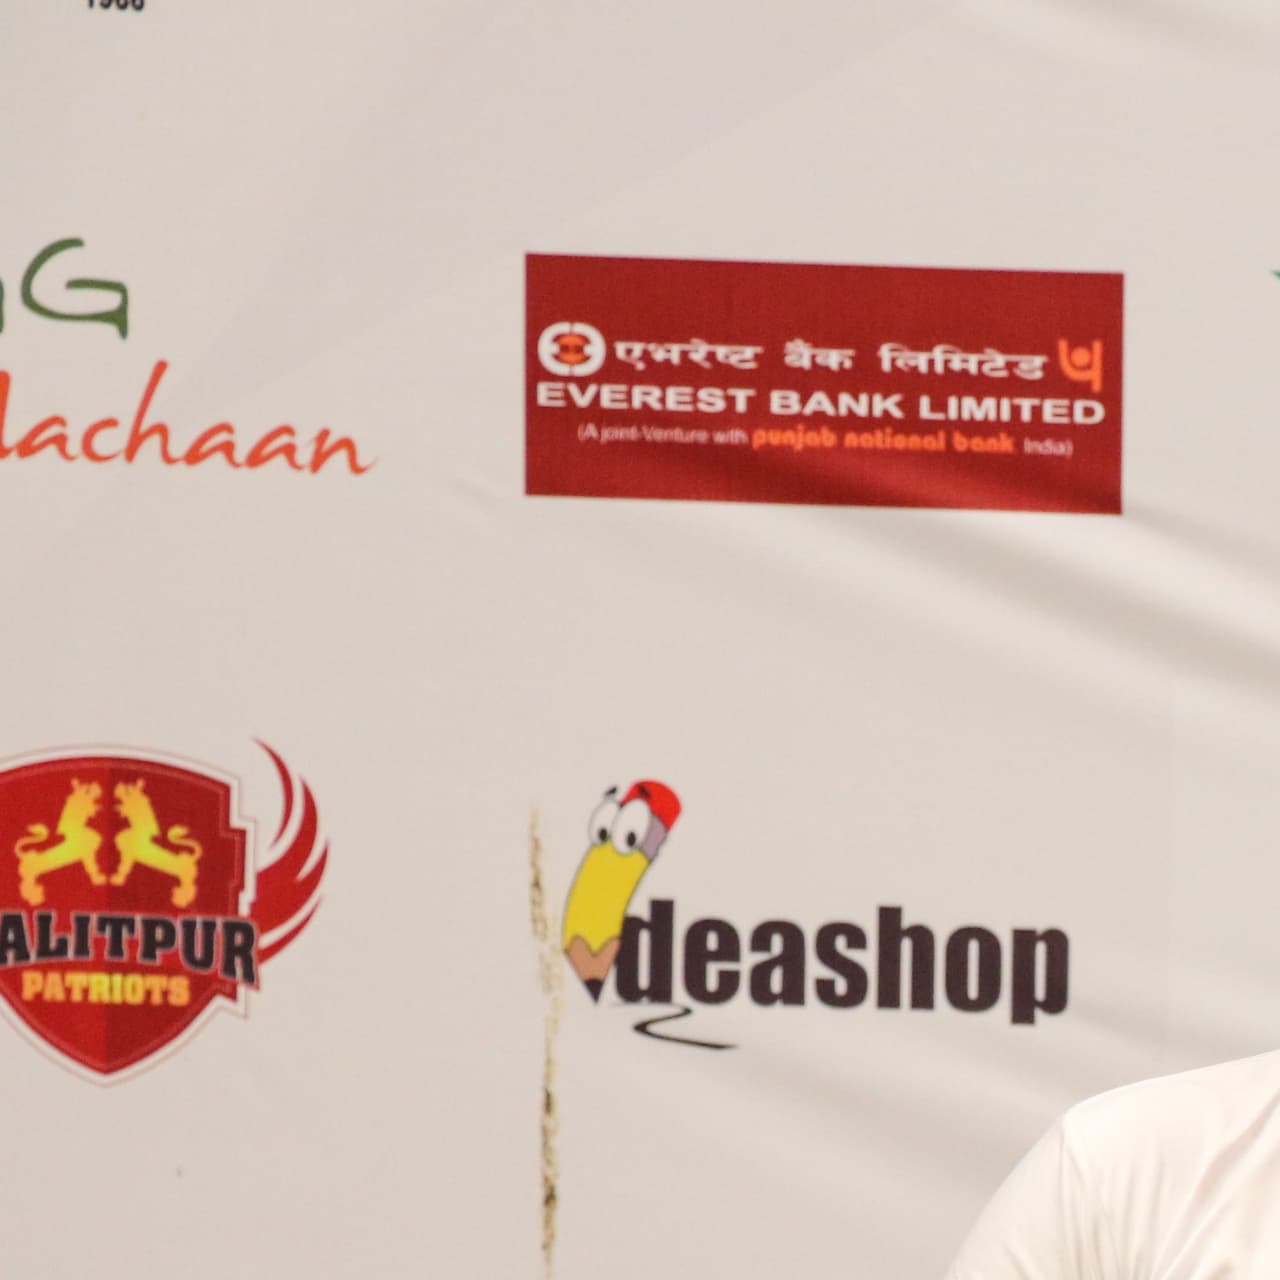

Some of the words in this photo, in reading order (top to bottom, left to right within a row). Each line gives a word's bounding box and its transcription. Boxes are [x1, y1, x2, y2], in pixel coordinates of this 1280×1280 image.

[536, 380, 756, 414] EVEREST
[769, 388, 905, 420] BANK
[918, 395, 1107, 427] LIMITED
[712, 427, 749, 447] with
[751, 424, 837, 454] punjab
[843, 426, 947, 453] national
[952, 430, 1016, 454] bank
[21, 970, 191, 1006] PATRIOTS
